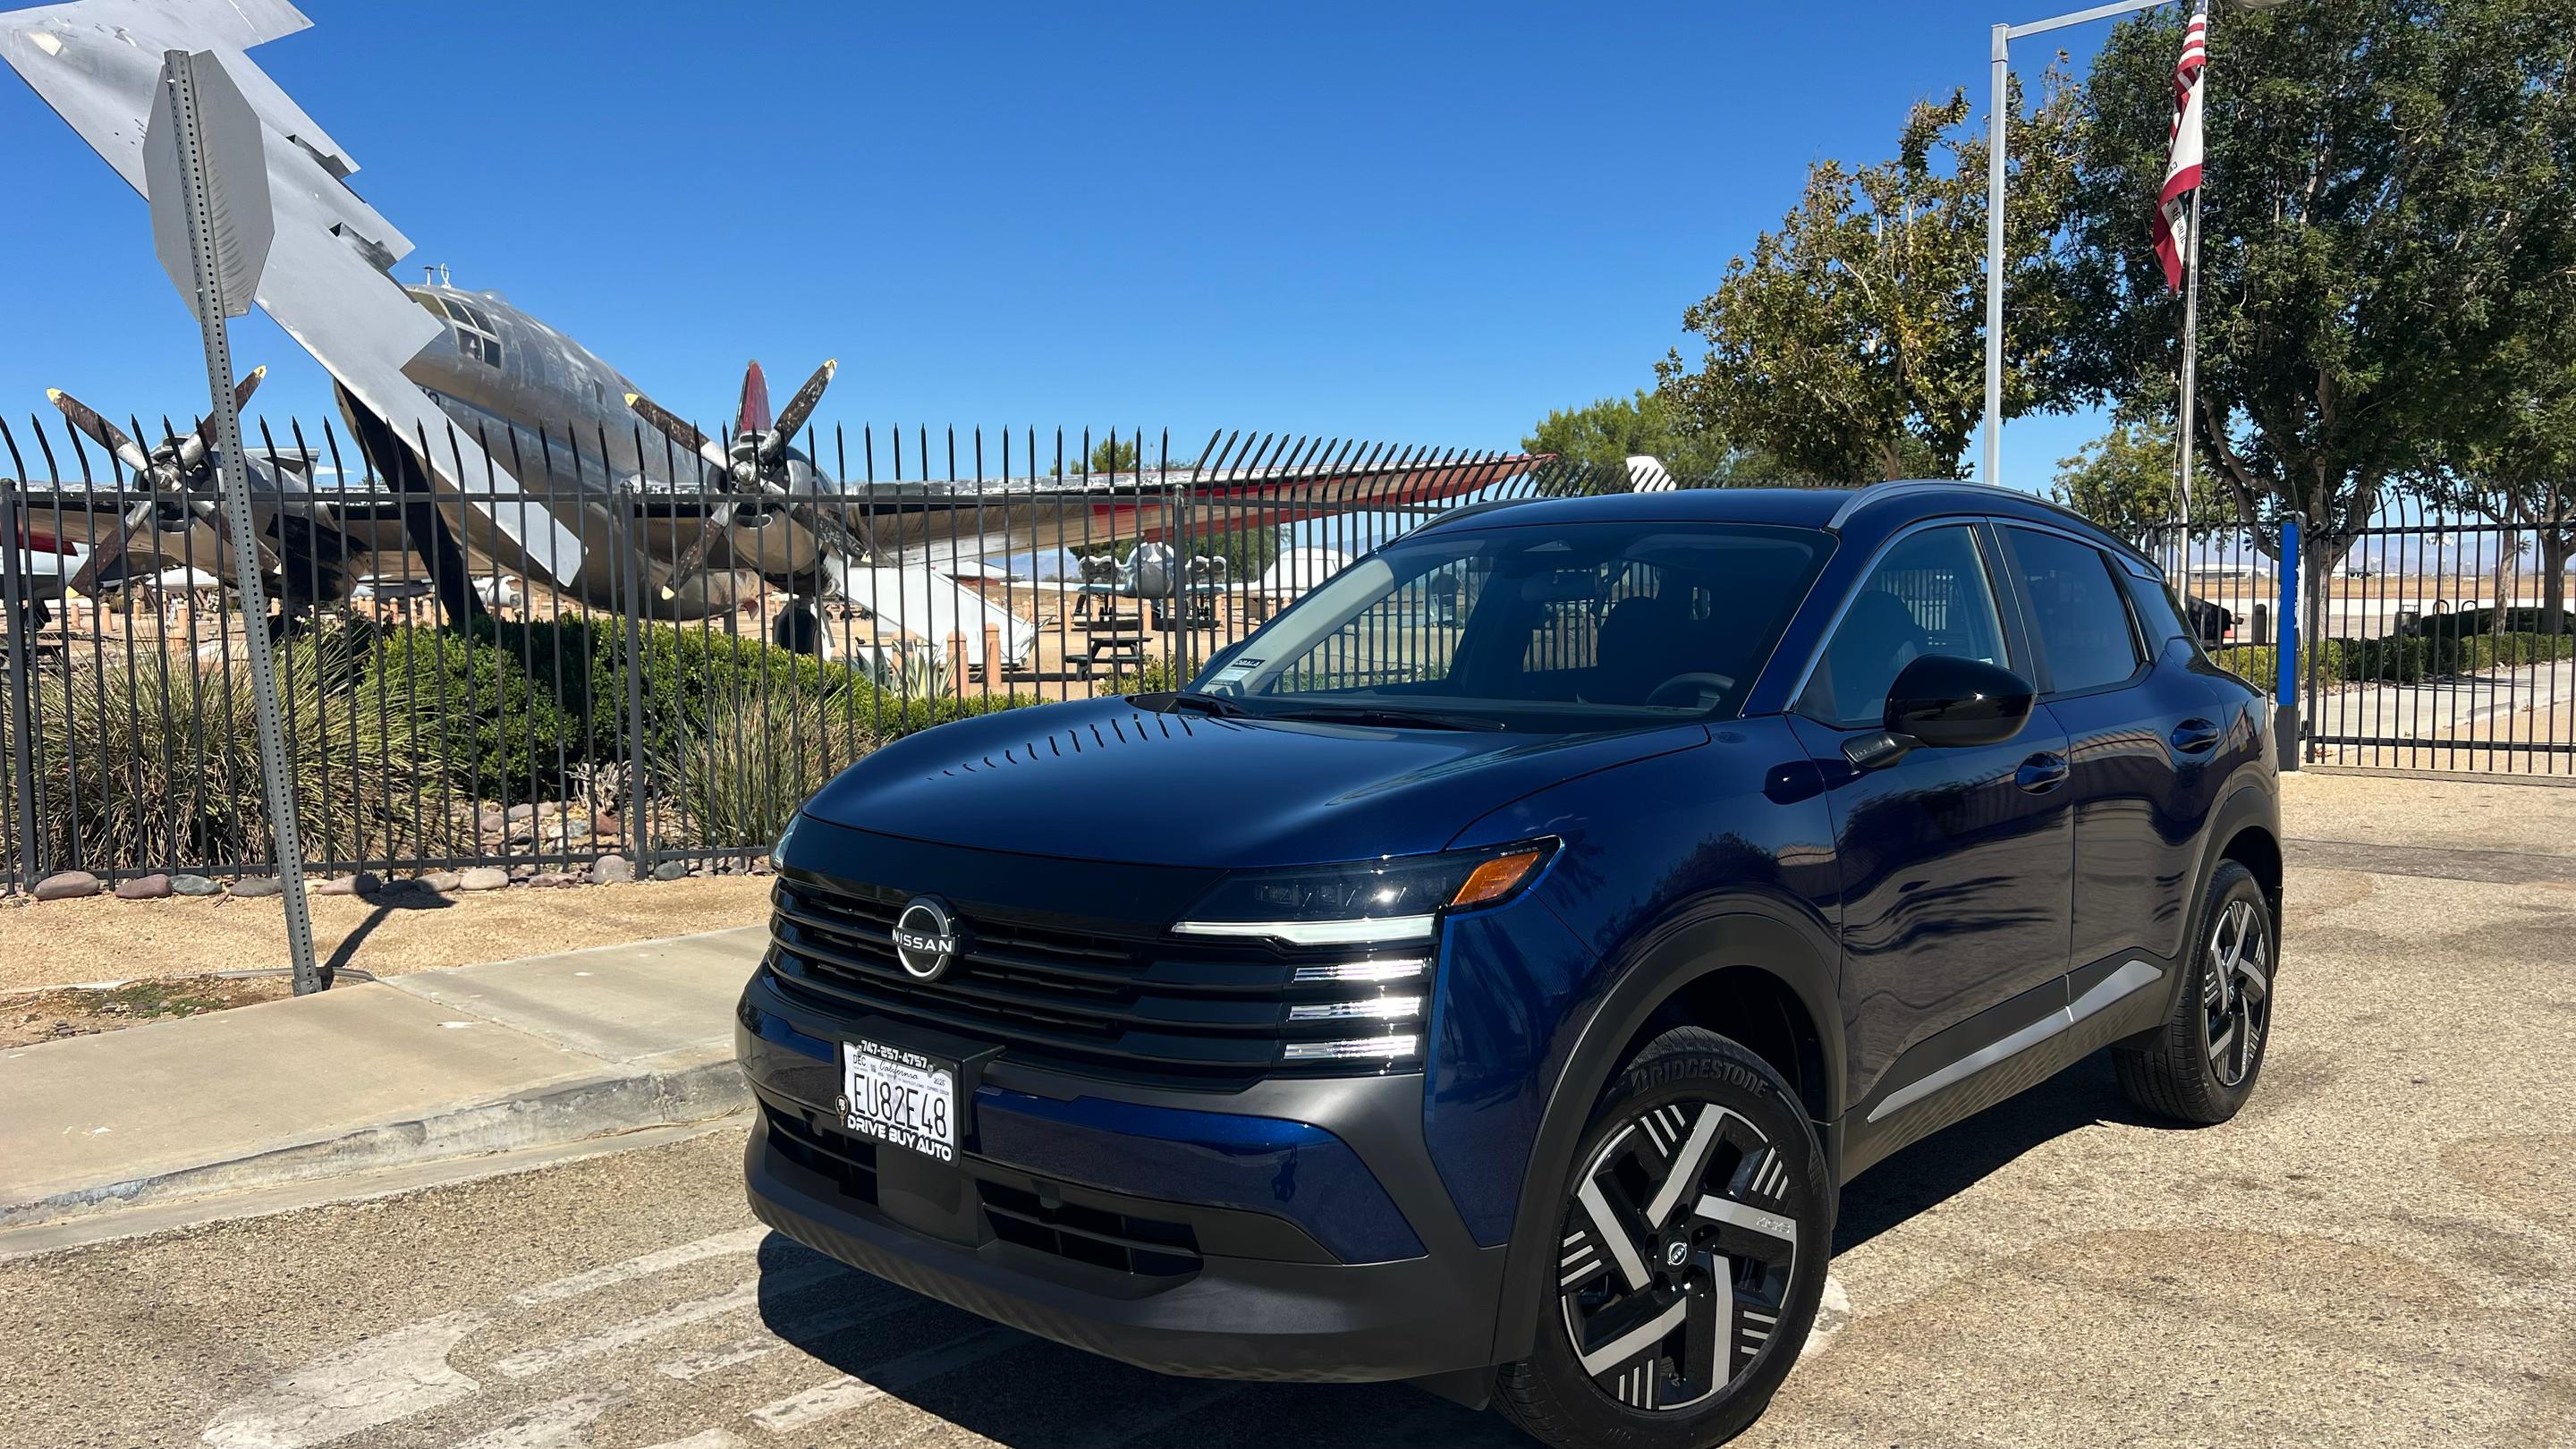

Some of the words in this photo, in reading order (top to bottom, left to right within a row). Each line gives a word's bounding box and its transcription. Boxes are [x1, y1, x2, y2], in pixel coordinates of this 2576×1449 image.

[892, 928, 953, 953] NISSAN
[852, 1055, 867, 1066] DEC
[860, 1039, 928, 1069] 747-257-4757
[880, 1059, 919, 1080] California
[1630, 1058, 1771, 1098] BRIDGESTONE
[854, 1072, 946, 1139] EU82E48
[847, 1114, 886, 1139] DRIVE
[888, 1127, 916, 1148] BUY
[916, 1137, 953, 1162] AUTO
[1756, 1216, 1791, 1233] KICKS
